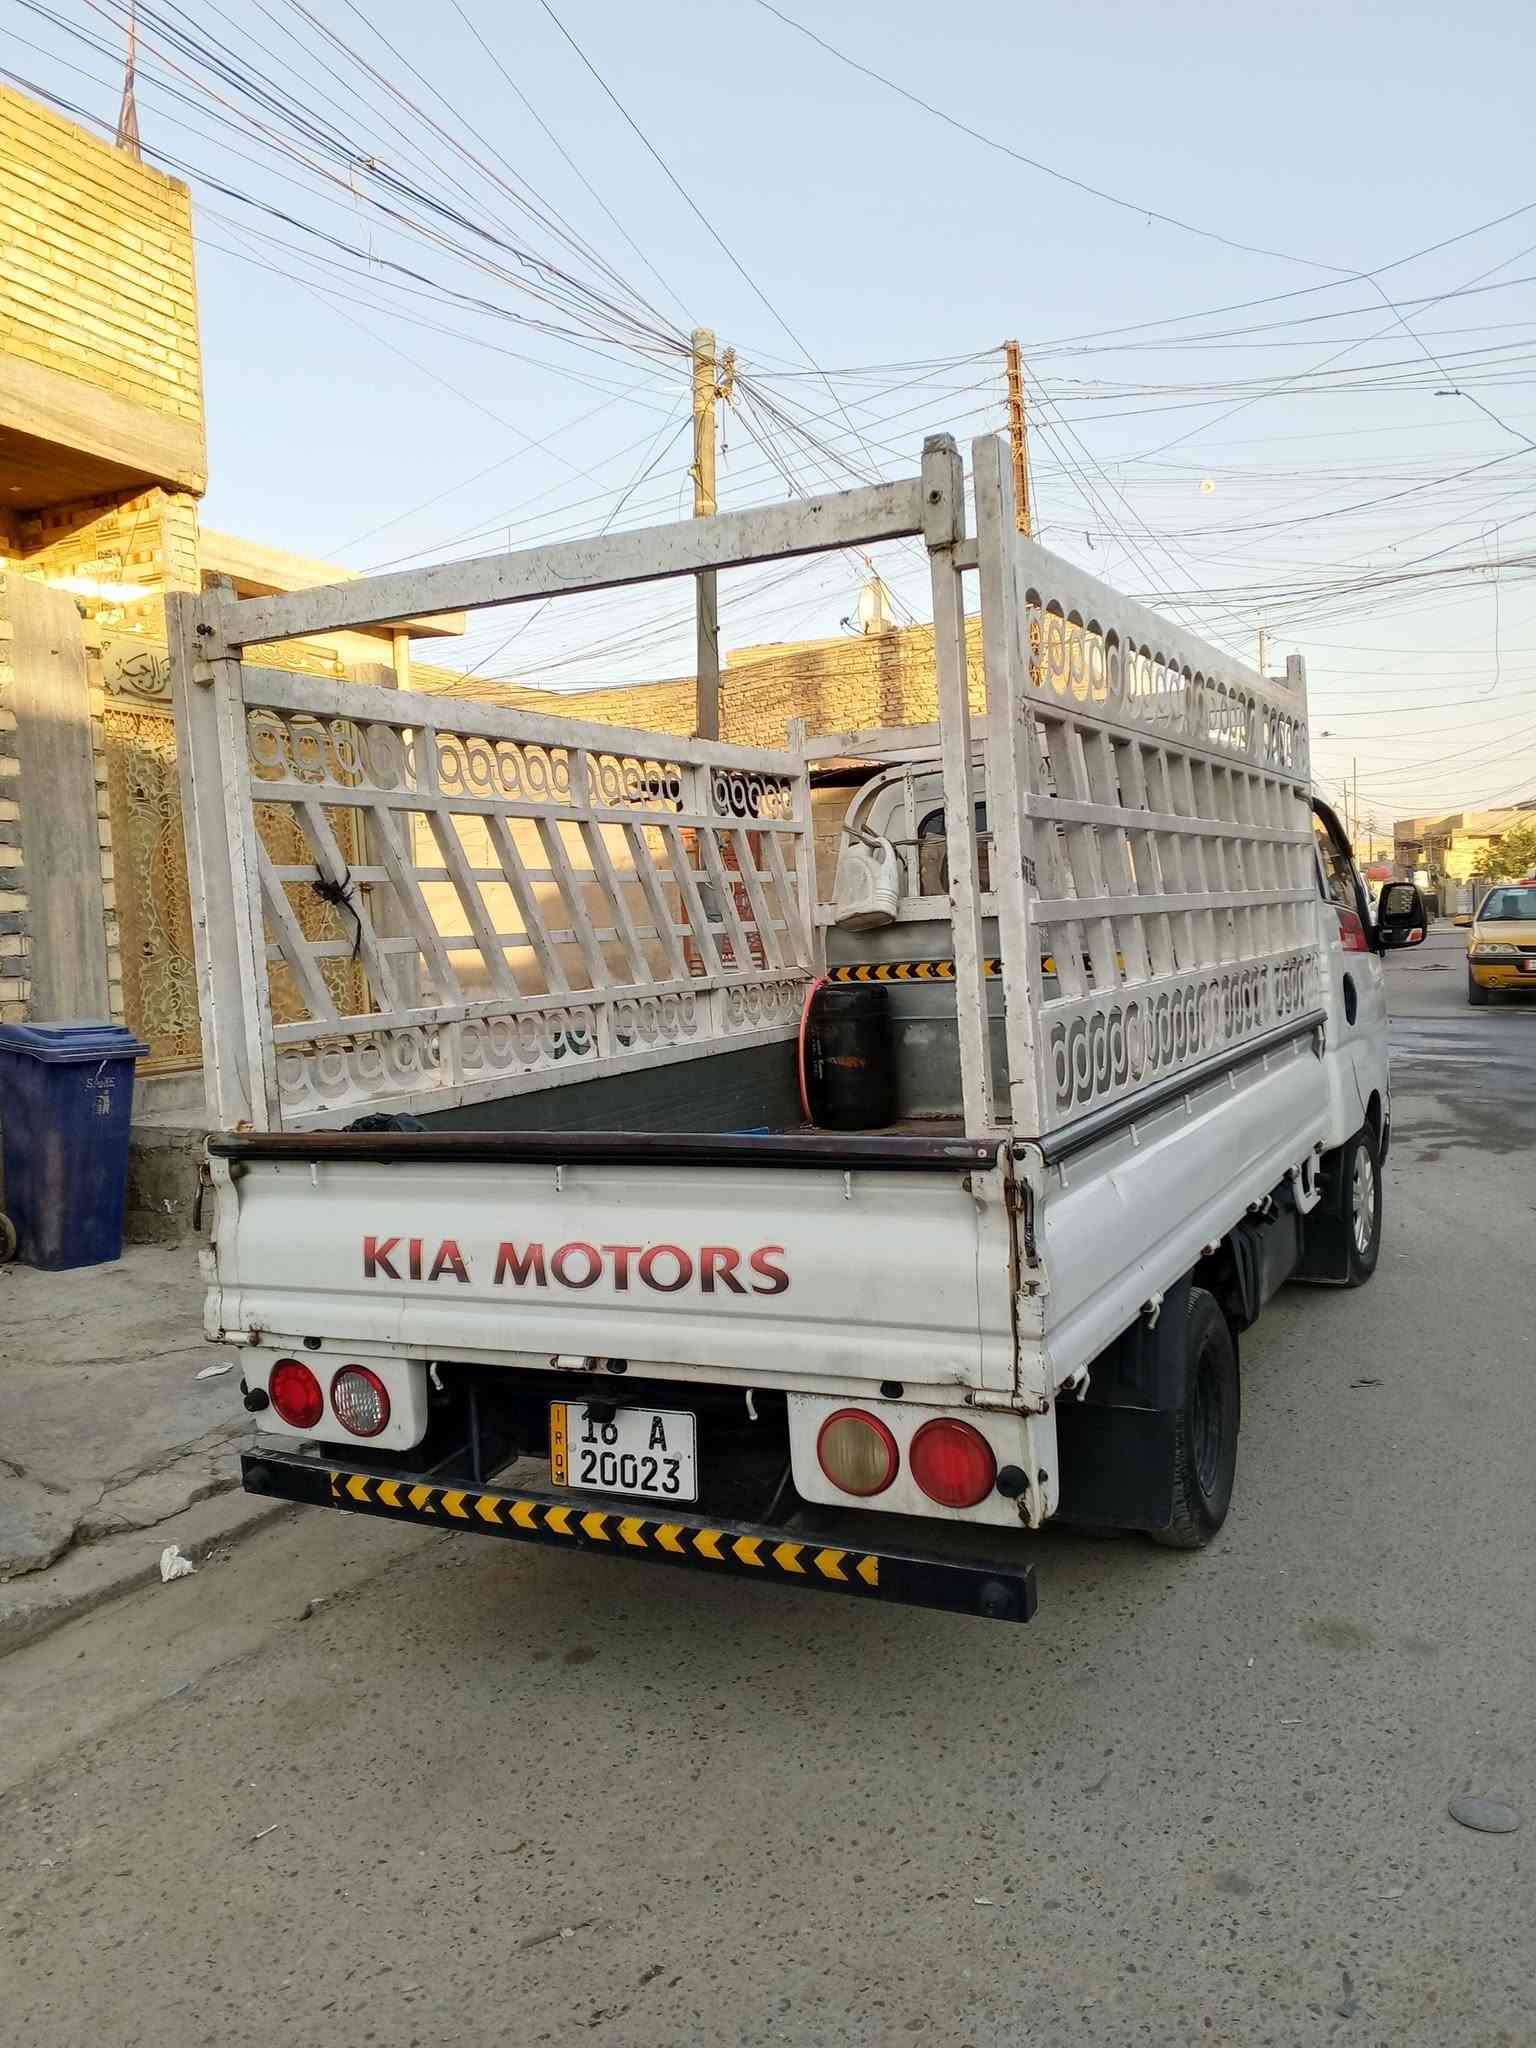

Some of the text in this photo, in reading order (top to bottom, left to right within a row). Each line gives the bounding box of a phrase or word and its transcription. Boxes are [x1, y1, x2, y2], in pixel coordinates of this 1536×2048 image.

[363, 1236, 790, 1296] KIA MOTORS
[649, 1415, 667, 1451] A
[580, 1449, 680, 1494] 20023
